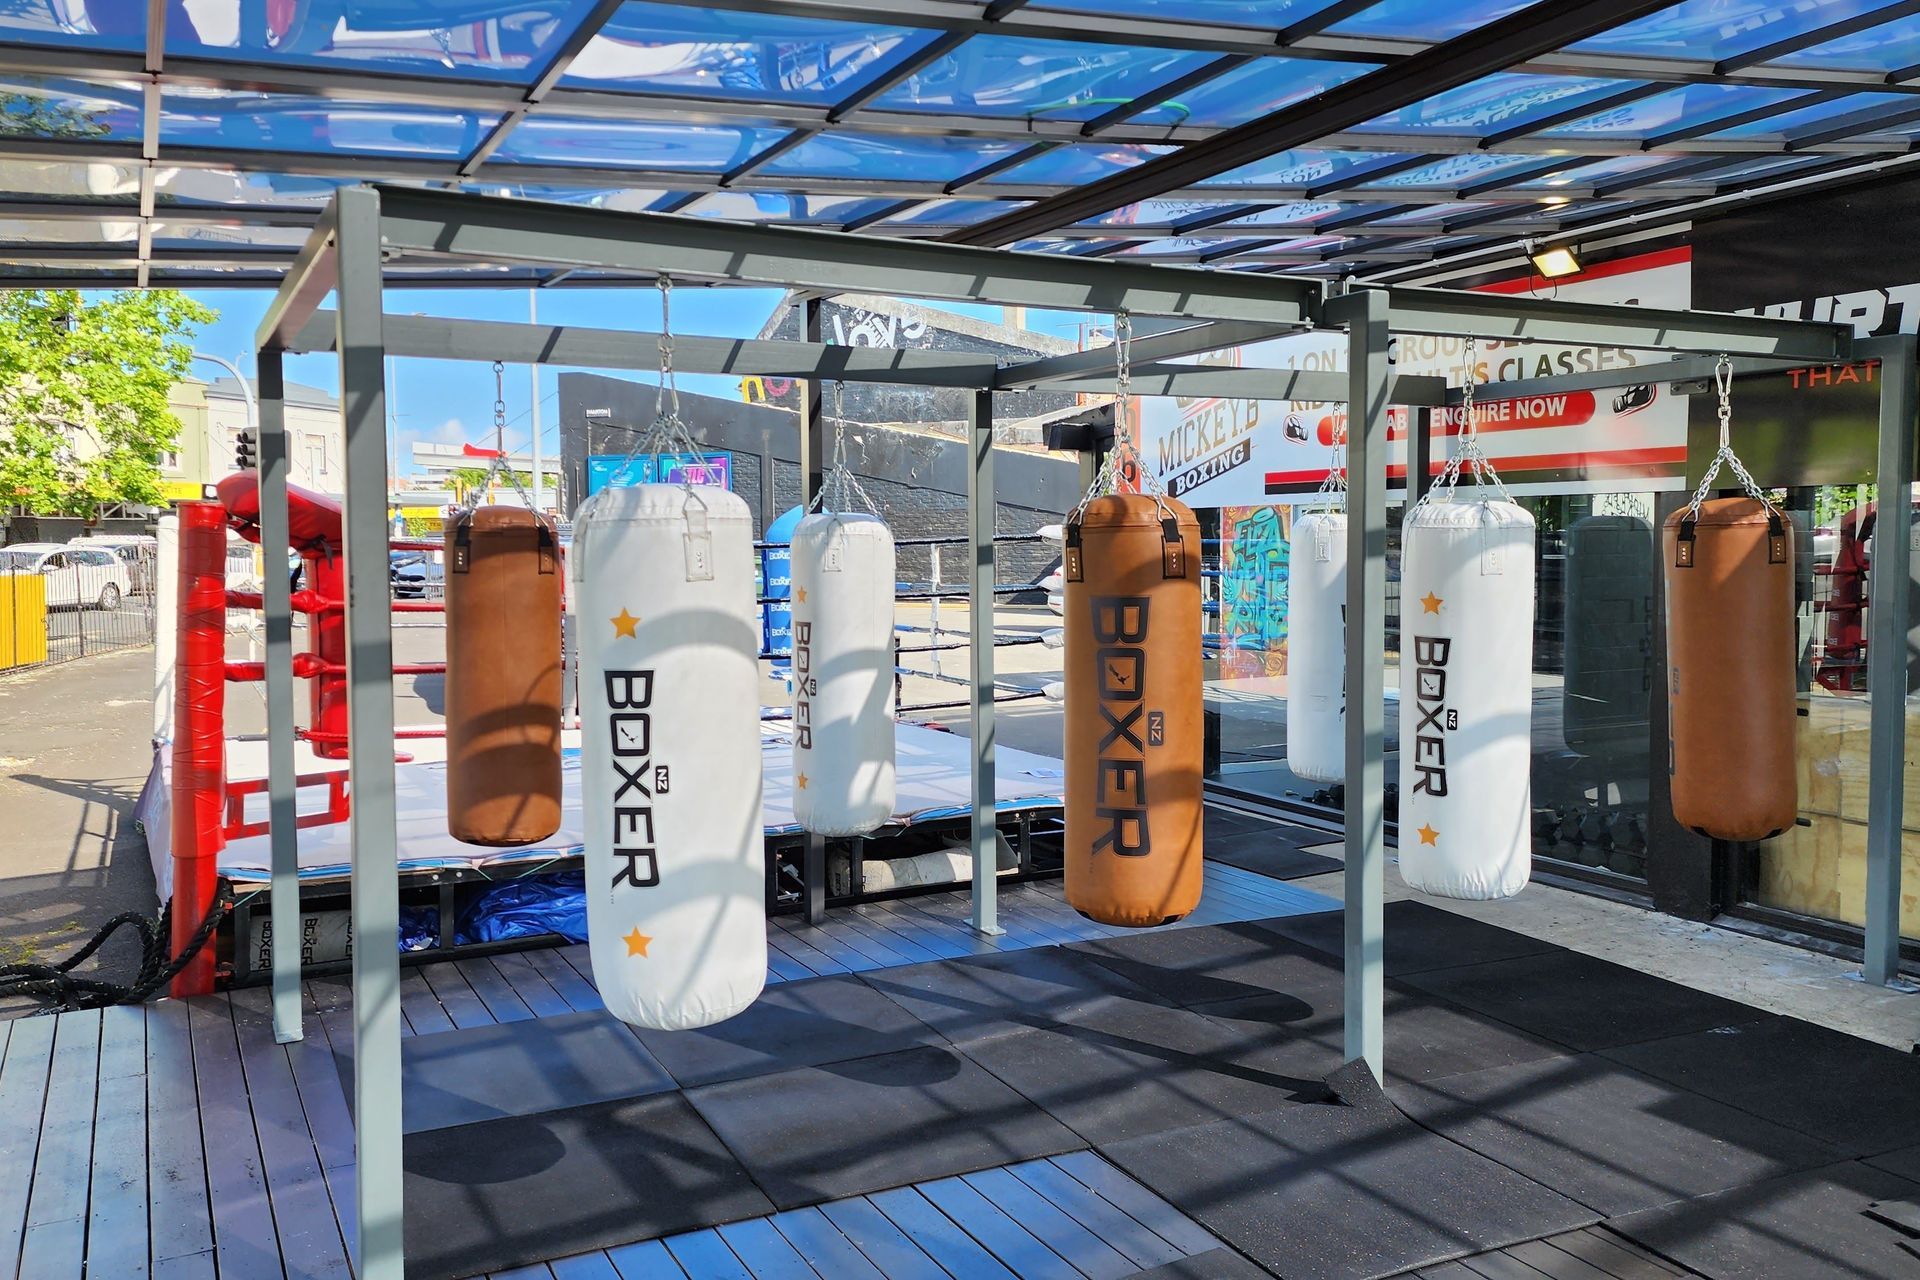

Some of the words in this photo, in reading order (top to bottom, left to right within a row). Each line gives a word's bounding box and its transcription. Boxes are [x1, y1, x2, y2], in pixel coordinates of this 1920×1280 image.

[1786, 359, 1880, 389] THAT
[1516, 396, 1567, 419] NOW
[1175, 444, 1245, 496] BOXING
[795, 621, 812, 750] BOXER
[1091, 596, 1151, 857] BOXER
[1150, 715, 1163, 743] NZ
[1413, 636, 1451, 797] BOXER
[1448, 711, 1457, 729] NZ
[604, 669, 660, 889] BOXER
[656, 767, 669, 792] NZ
